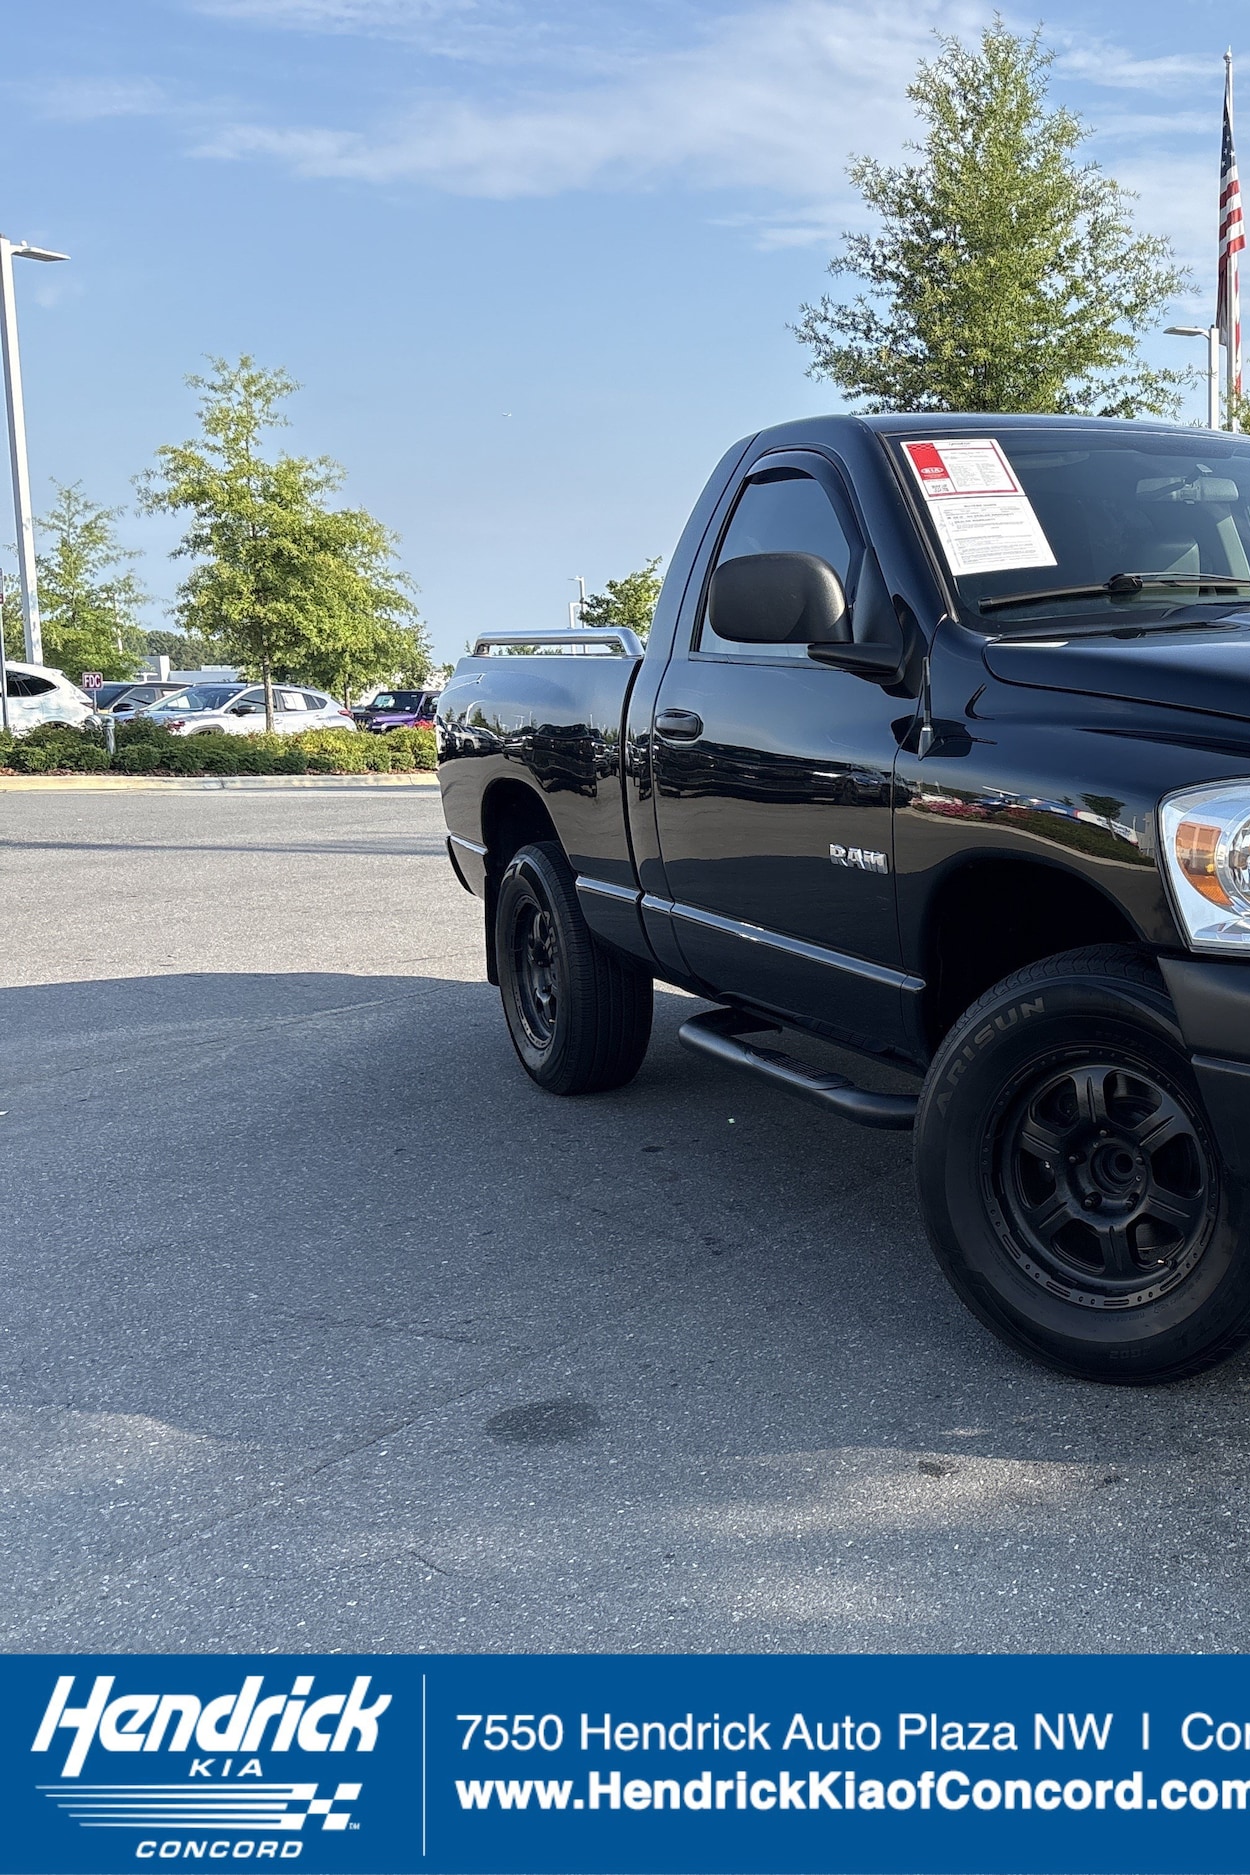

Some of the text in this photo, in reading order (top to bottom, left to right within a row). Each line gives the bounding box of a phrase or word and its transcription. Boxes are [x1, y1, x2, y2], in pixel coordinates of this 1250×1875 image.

[84, 674, 101, 688] FDC
[829, 843, 889, 874] RAM
[936, 997, 1045, 1118] ARISUN
